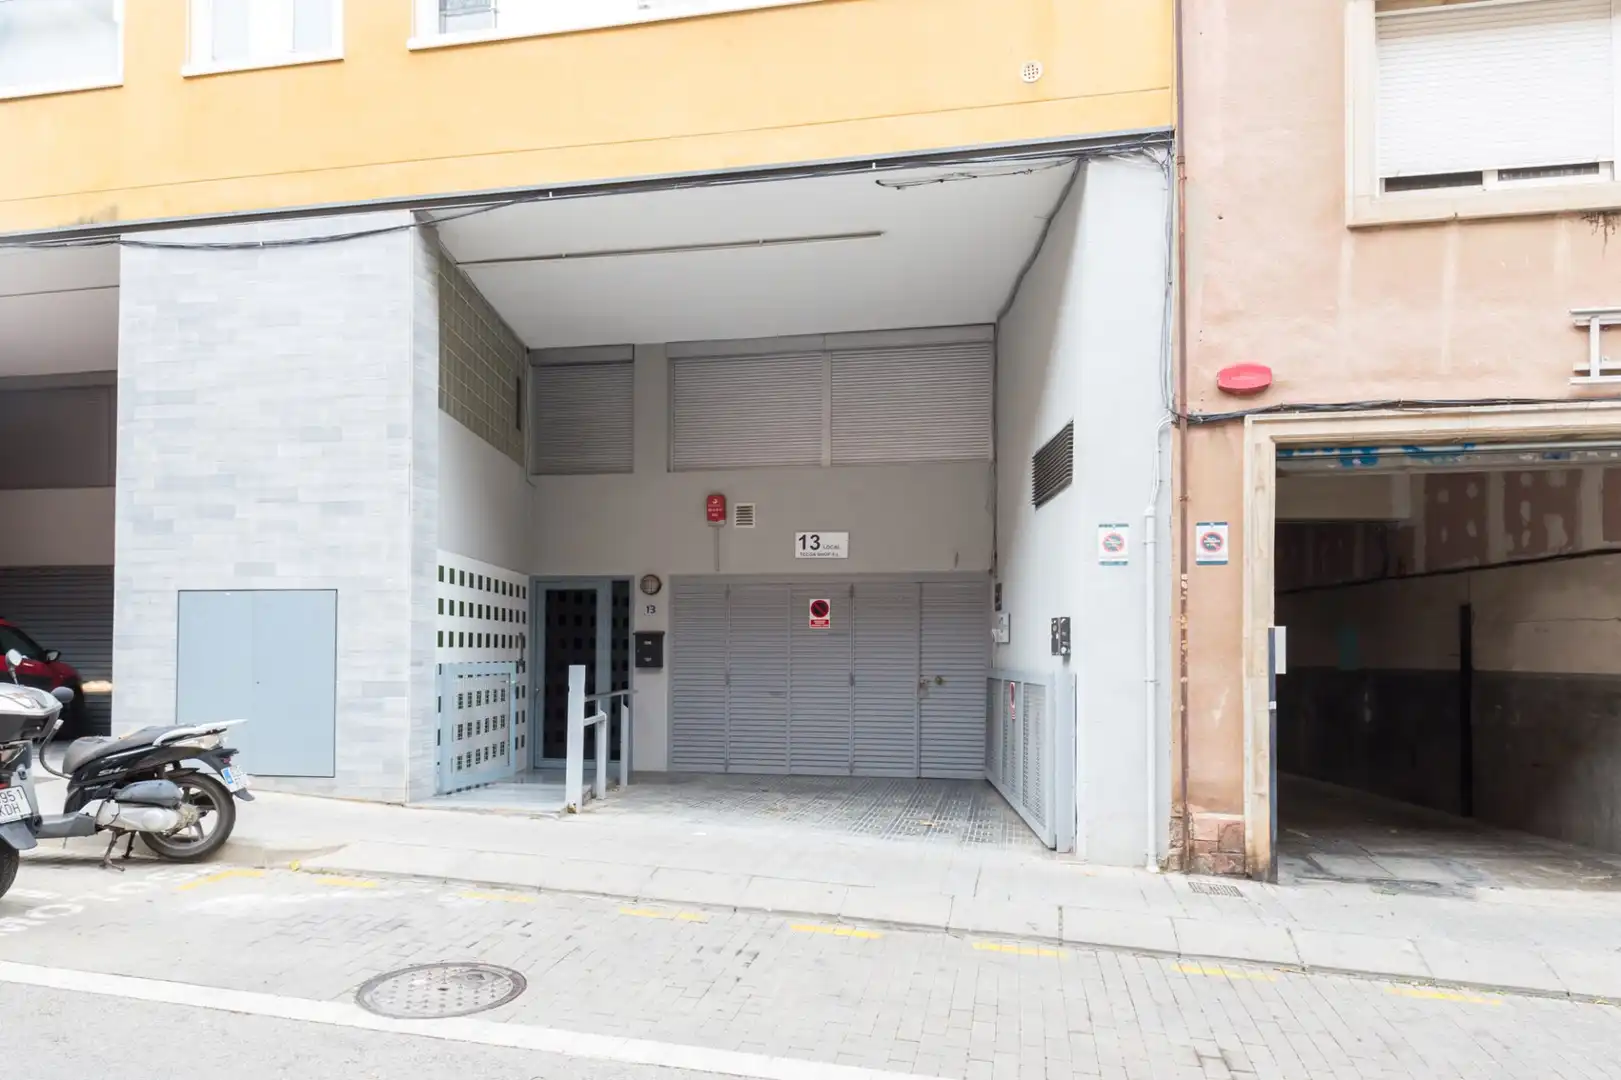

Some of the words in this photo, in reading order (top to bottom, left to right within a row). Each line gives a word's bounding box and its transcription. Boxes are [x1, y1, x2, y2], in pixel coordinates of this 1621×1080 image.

[799, 534, 821, 550] 13
[646, 604, 657, 615] 13
[0, 788, 23, 804] 951
